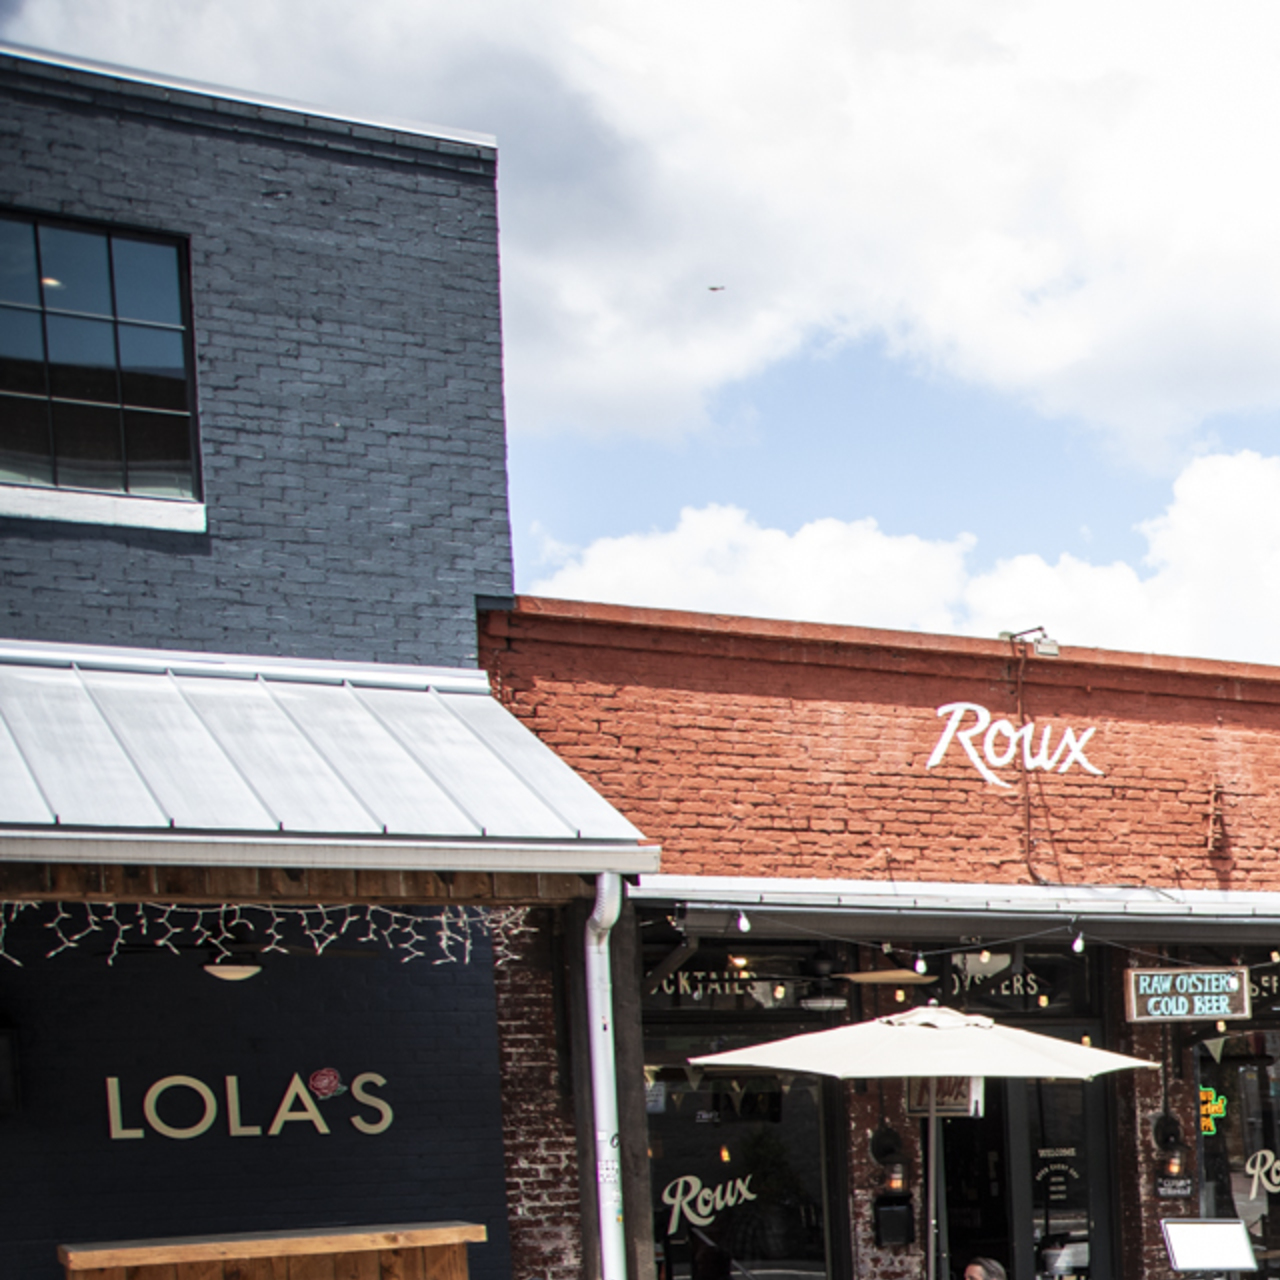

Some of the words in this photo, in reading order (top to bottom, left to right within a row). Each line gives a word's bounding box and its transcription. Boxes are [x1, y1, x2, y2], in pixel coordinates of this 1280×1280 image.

[925, 702, 1105, 788] Roux
[1138, 975, 1173, 995] RAW
[1147, 995, 1190, 1016] COLD
[1193, 994, 1233, 1015] BEER
[662, 1174, 758, 1235] Roux
